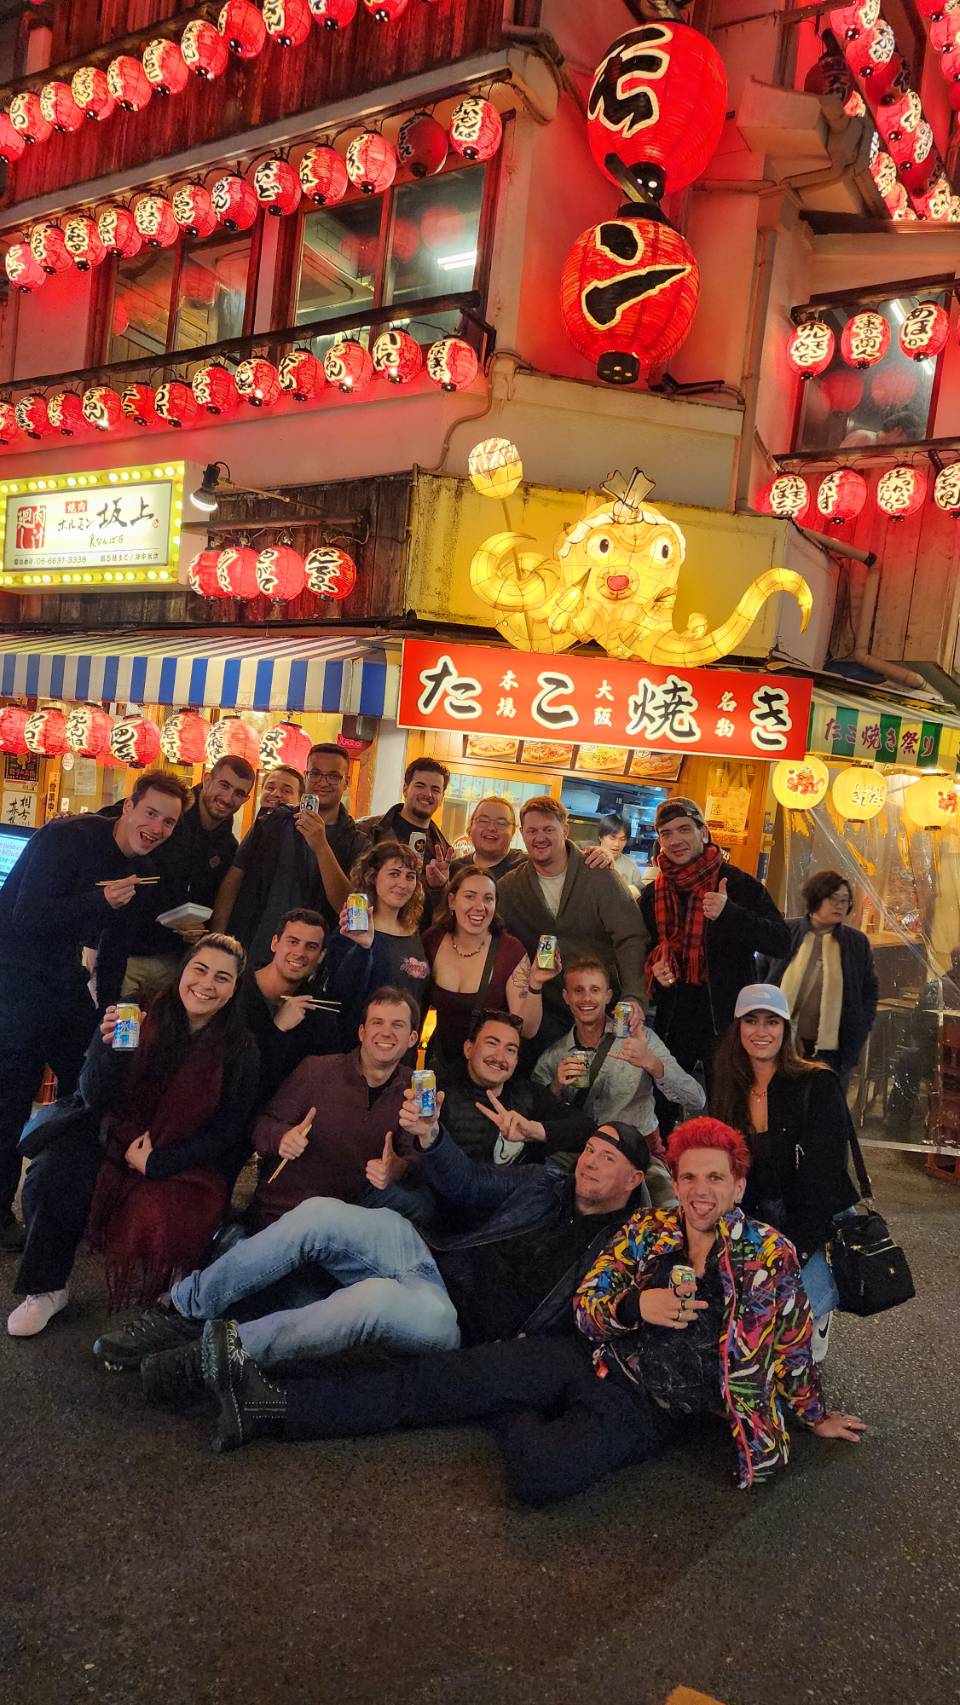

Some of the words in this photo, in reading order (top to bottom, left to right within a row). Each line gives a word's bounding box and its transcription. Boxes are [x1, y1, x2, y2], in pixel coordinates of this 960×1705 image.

[57, 518, 94, 532] ホルモン
[96, 496, 155, 529] 坂上
[417, 656, 792, 750] たこ焼き
[496, 670, 519, 719] 本場
[594, 680, 615, 728] 大阪
[715, 691, 738, 738] 名物
[824, 718, 935, 757] たこ焼き祭り
